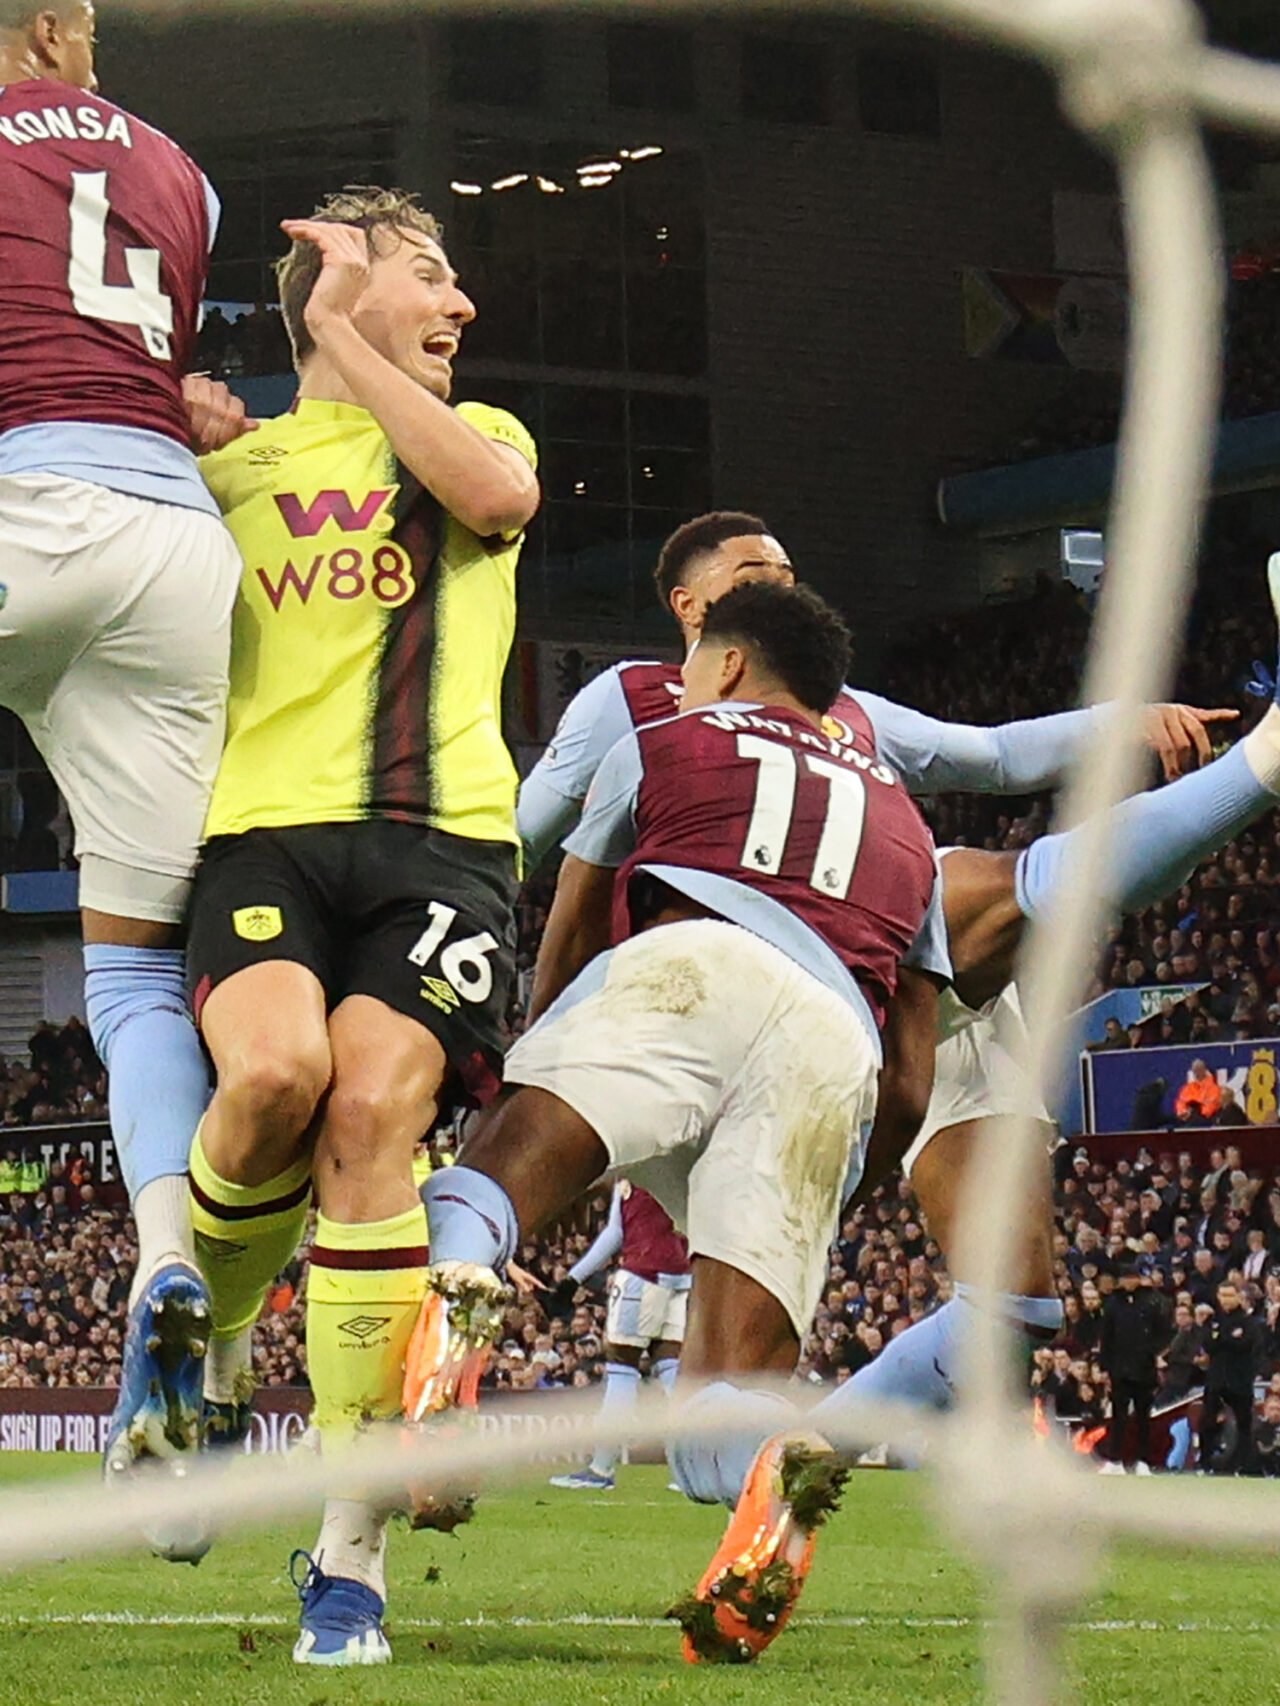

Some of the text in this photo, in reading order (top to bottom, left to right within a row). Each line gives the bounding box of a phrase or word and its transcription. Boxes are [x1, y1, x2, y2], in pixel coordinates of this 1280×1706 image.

[0, 106, 133, 148] KONSA
[67, 171, 173, 360] 4
[256, 546, 409, 614] W88
[736, 733, 867, 900] 11
[407, 901, 500, 1003] 16
[1, 1412, 36, 1451] SIGN
[40, 1414, 62, 1452] UP
[66, 1414, 97, 1452] FOR
